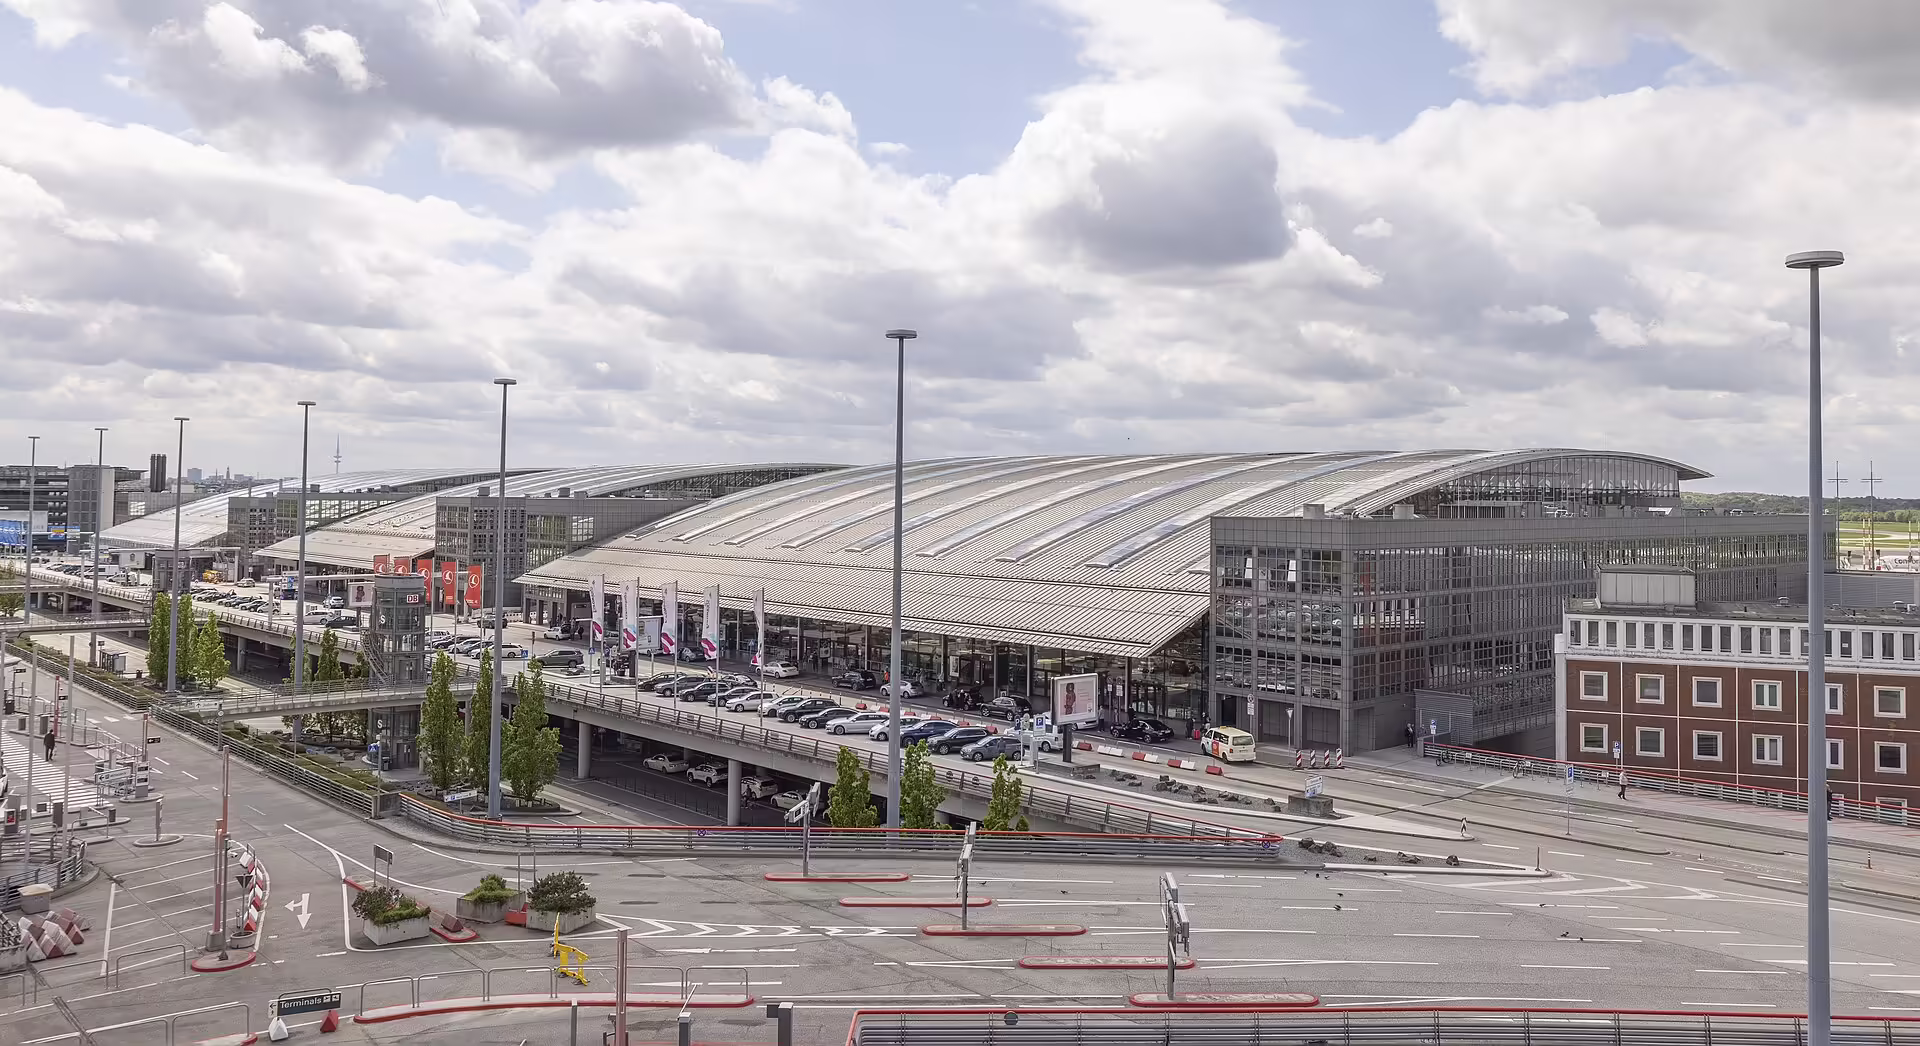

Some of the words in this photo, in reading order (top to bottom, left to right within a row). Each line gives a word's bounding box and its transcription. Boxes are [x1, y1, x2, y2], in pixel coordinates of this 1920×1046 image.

[1894, 557, 1919, 565] Conor
[380, 614, 386, 624] S
[377, 719, 383, 729] S
[280, 997, 322, 1009] Terminals
